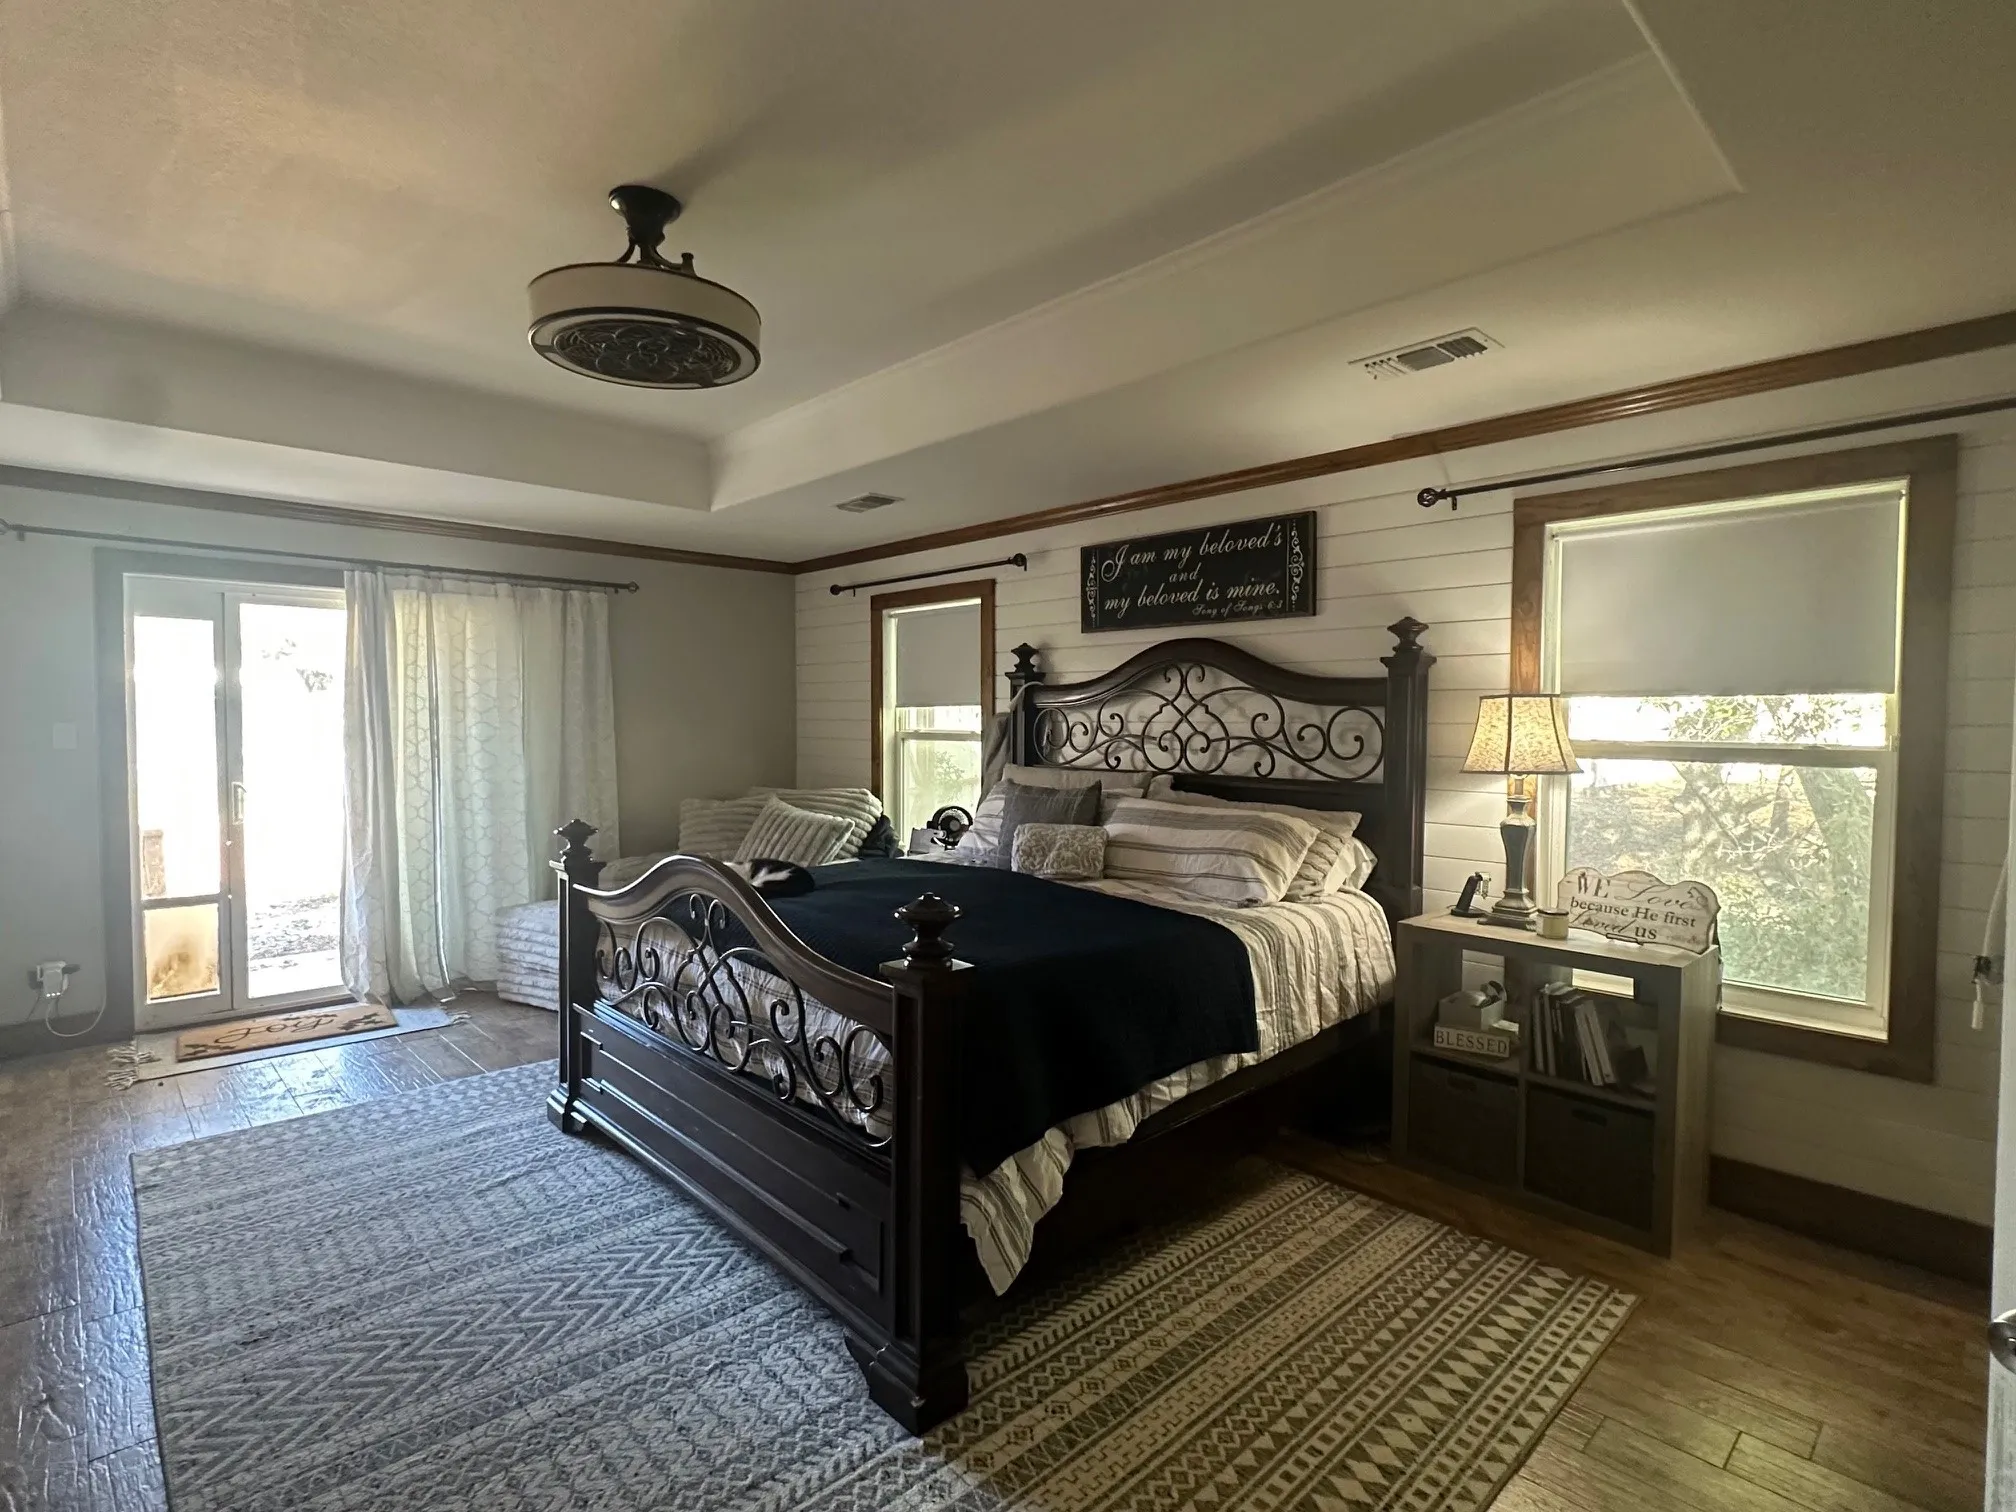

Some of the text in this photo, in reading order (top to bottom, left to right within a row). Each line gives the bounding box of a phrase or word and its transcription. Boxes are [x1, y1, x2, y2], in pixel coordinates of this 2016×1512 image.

[1101, 522, 1284, 582] I am my beloved's
[1169, 562, 1201, 583] and
[1104, 577, 1280, 618] my beloved is mine.
[1192, 604, 1218, 618] Song
[1220, 602, 1233, 617] of
[1233, 600, 1263, 615] Songs
[1577, 873, 1702, 911] WE Love
[1570, 896, 1697, 928] because He first
[1635, 926, 1658, 940] us
[1436, 1030, 1508, 1053] BLESSED
